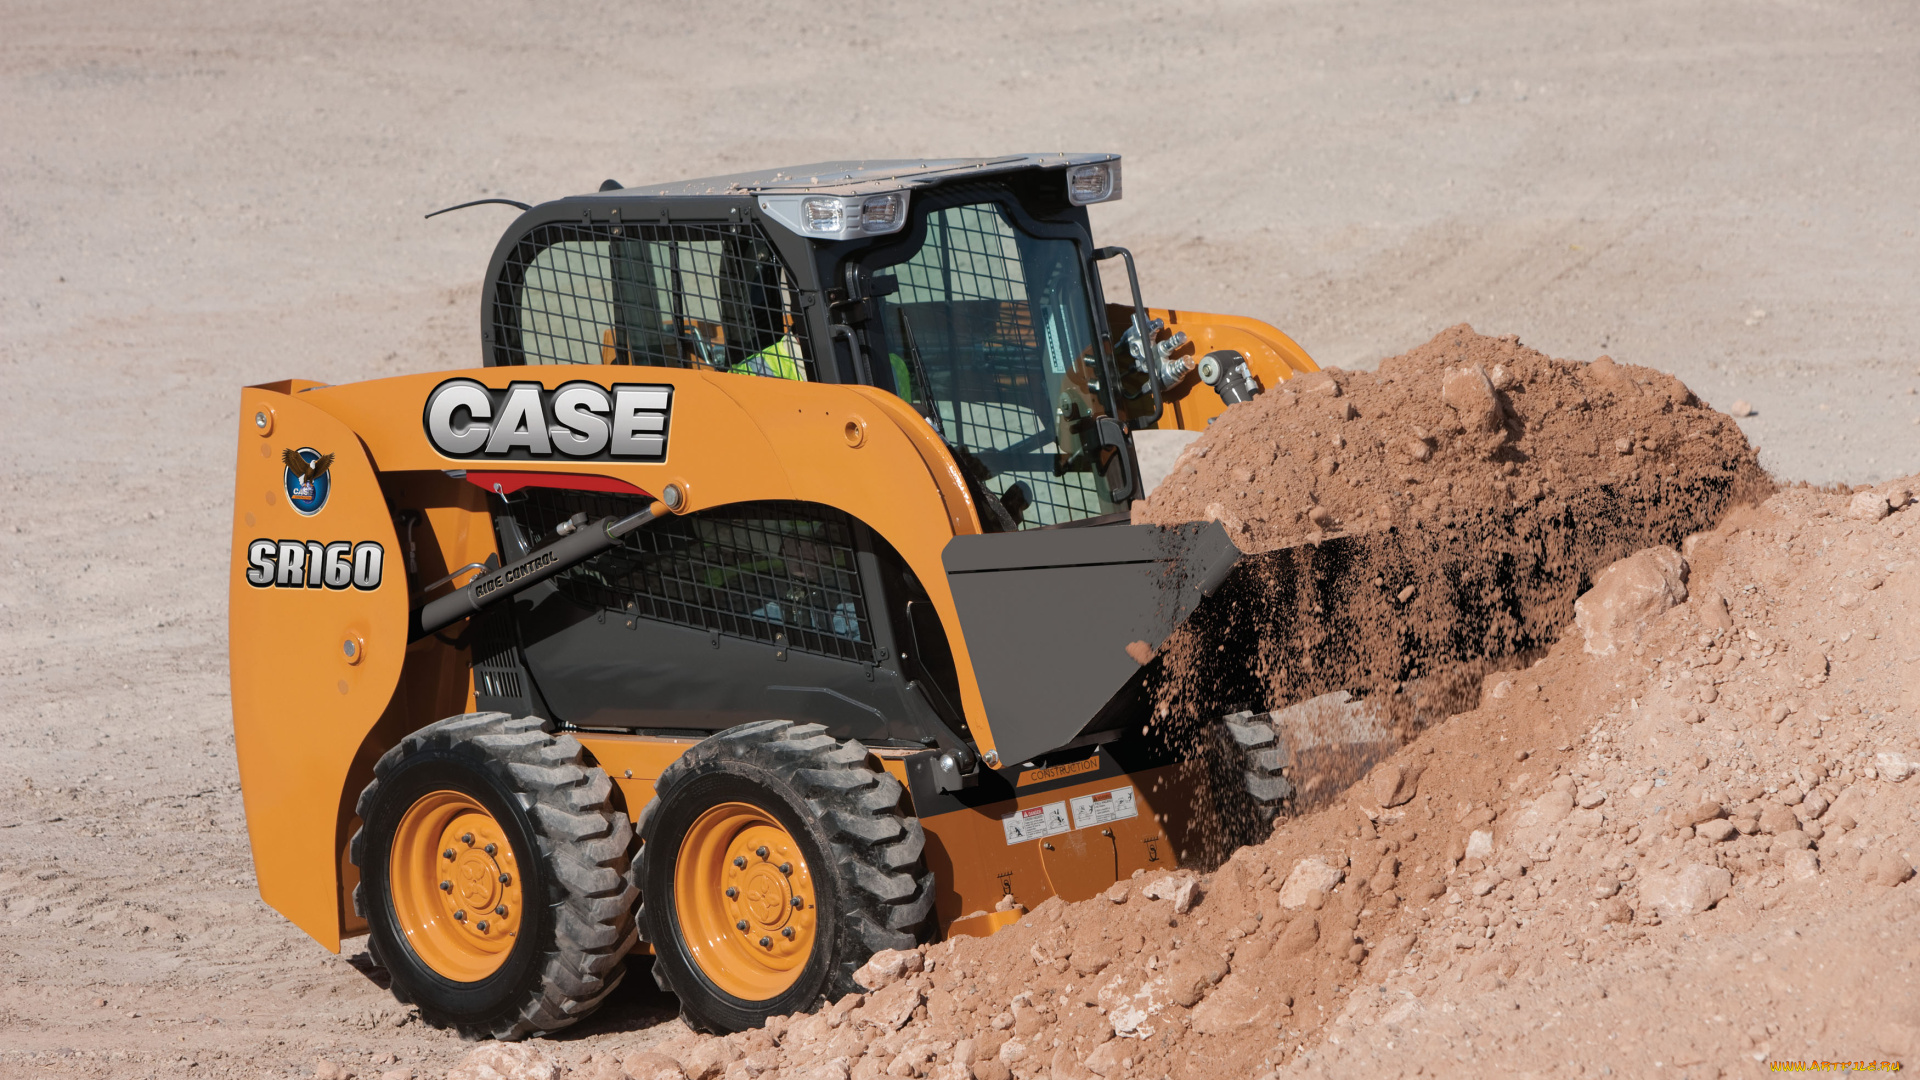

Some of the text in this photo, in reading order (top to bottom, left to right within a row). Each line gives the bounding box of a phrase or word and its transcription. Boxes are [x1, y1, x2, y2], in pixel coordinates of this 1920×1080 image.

[425, 379, 673, 460] CASE
[247, 538, 384, 590] SR160
[475, 551, 559, 598] RIDE CONTROL
[1031, 758, 1098, 781] CONSTRUCTION
